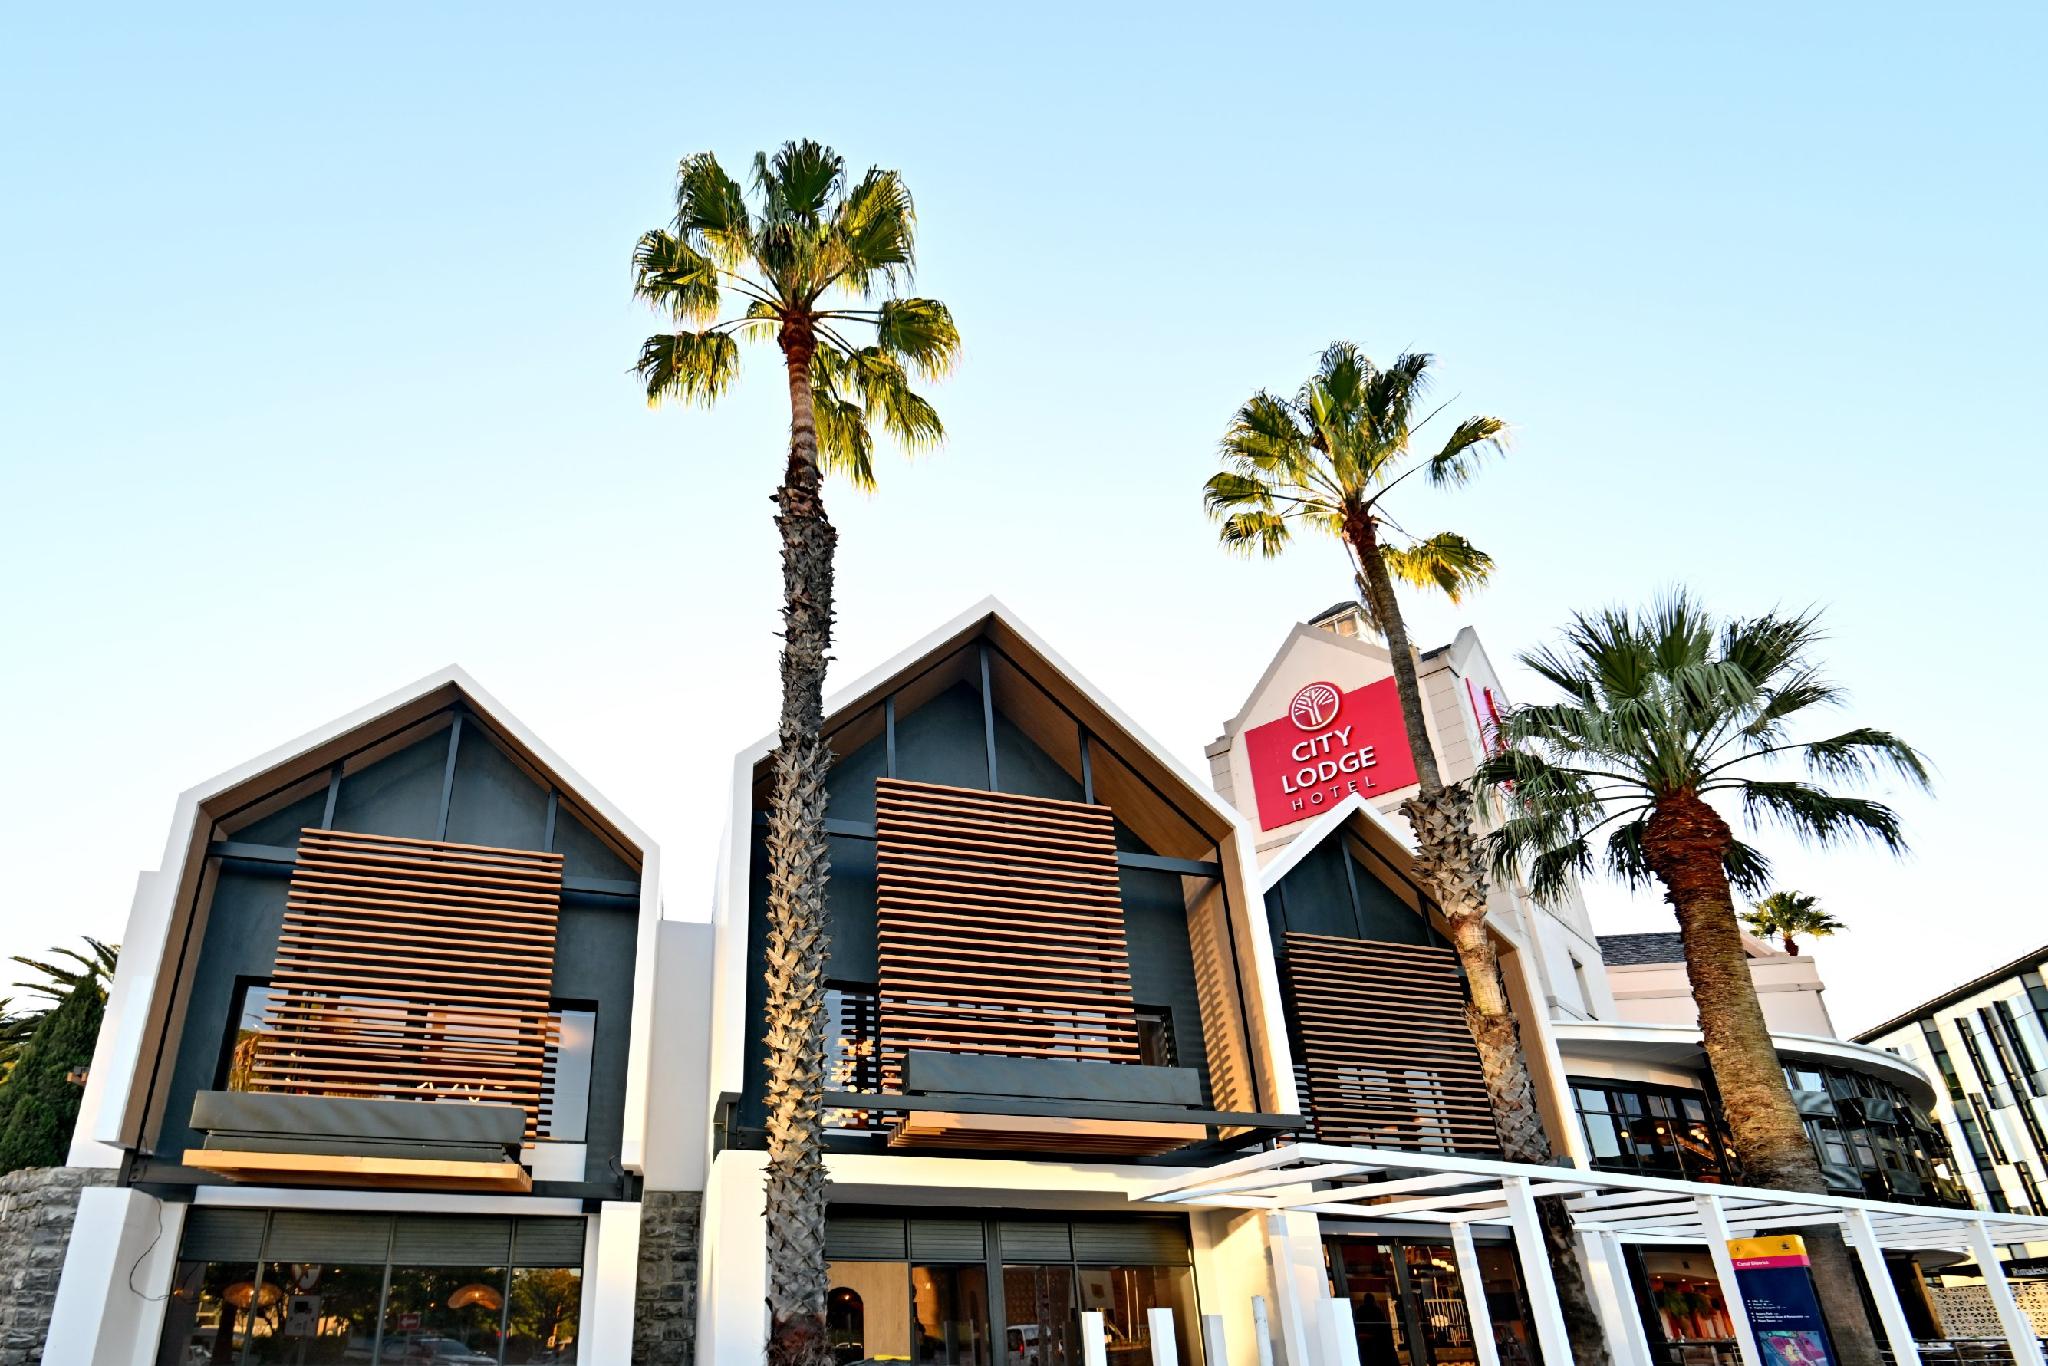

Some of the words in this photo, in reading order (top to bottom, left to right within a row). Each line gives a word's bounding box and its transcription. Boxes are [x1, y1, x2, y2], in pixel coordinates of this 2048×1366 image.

[1291, 725, 1351, 762] CITY
[1281, 745, 1376, 793] LODGE
[1291, 776, 1376, 811] HOTEL
